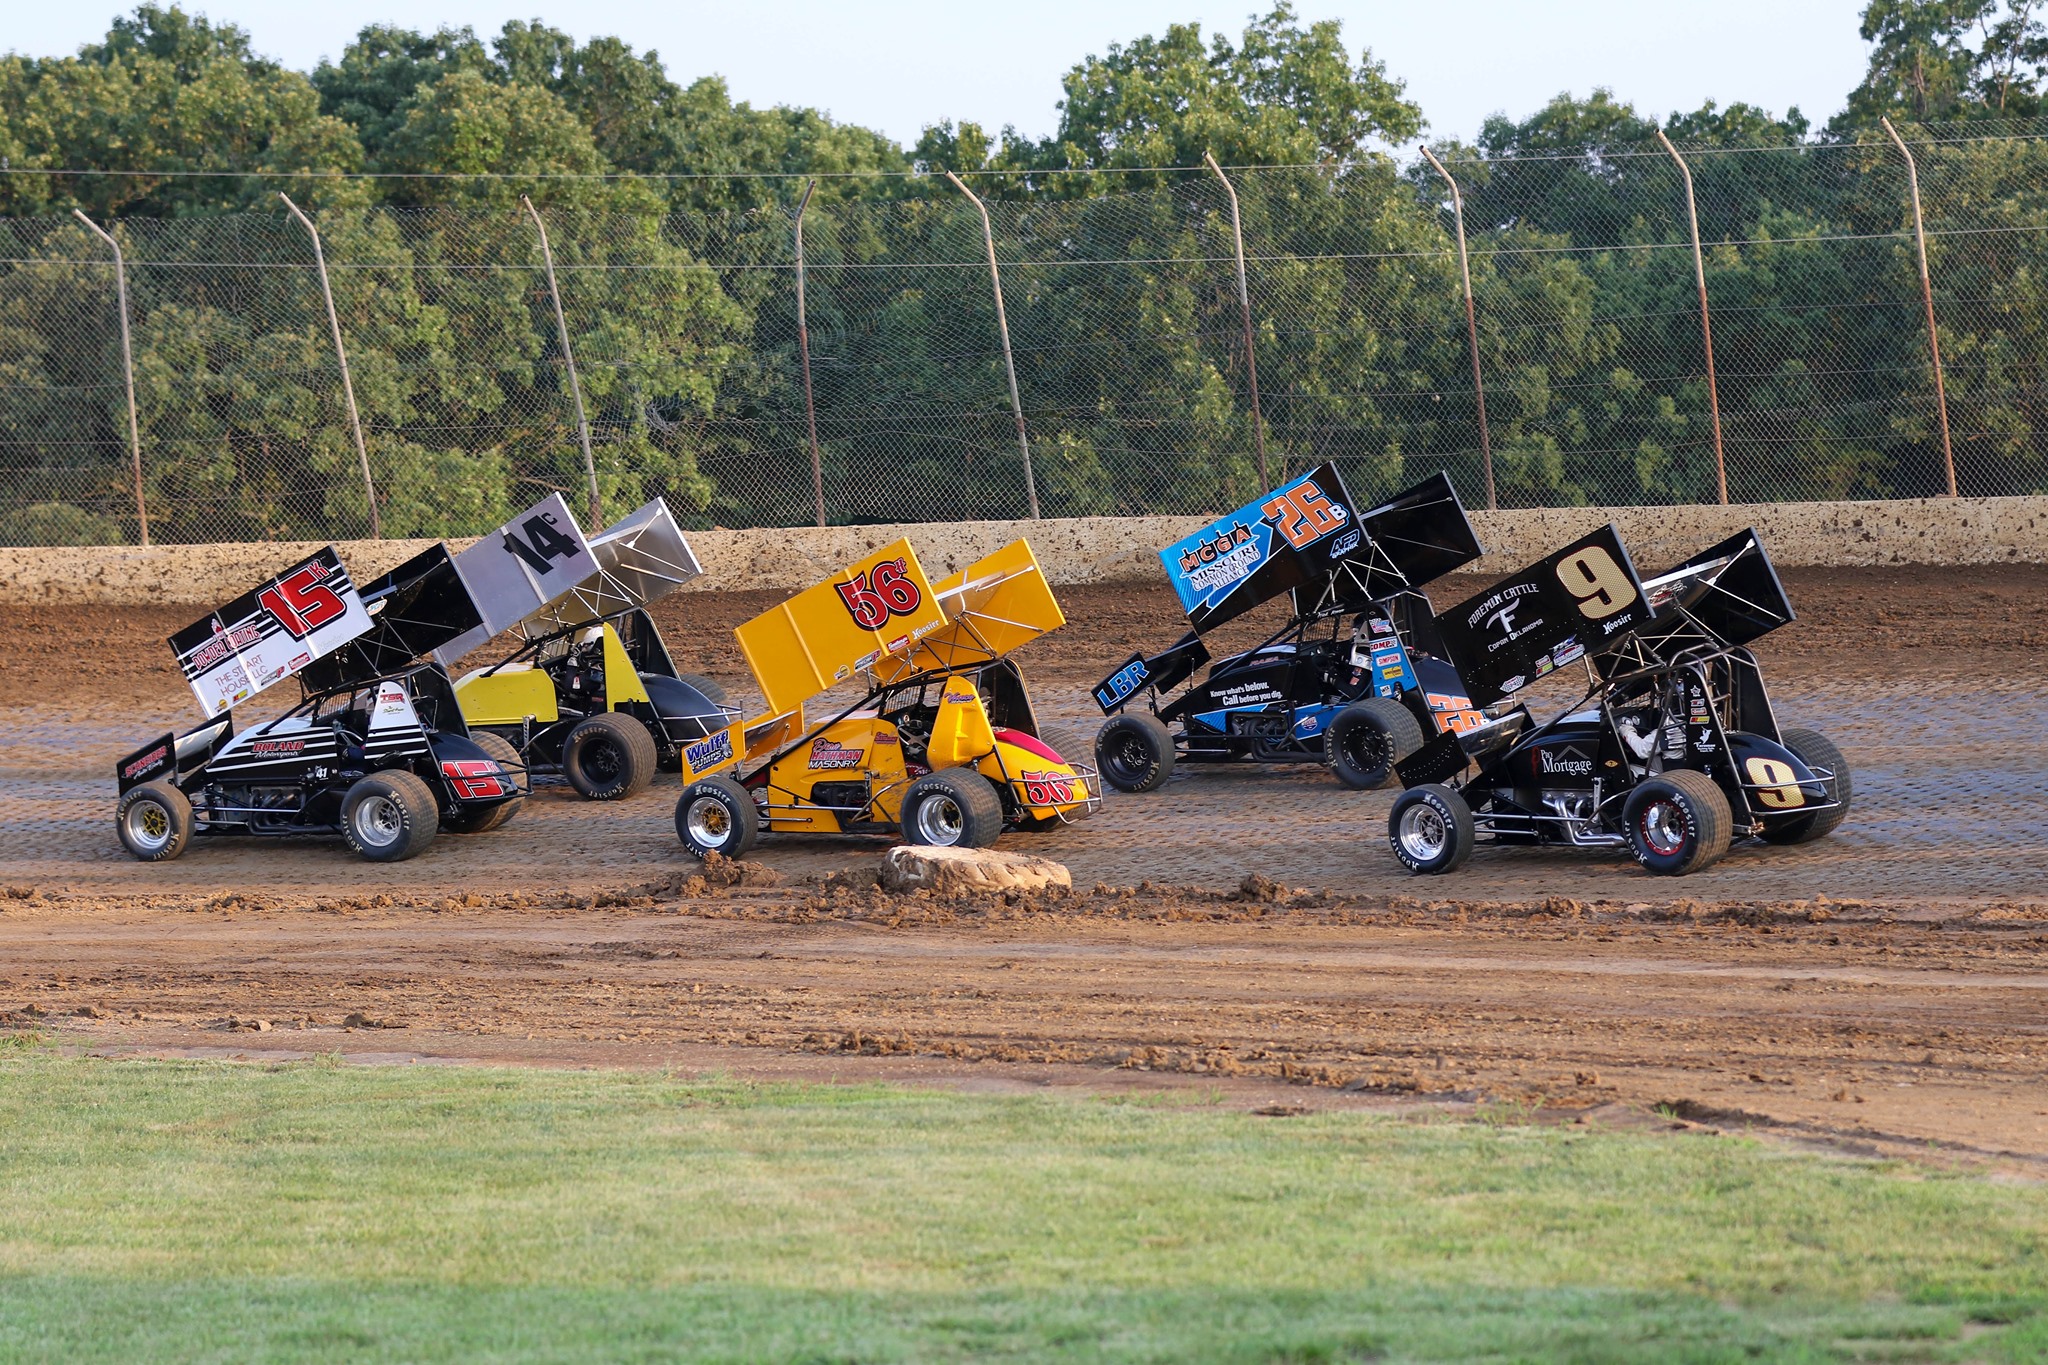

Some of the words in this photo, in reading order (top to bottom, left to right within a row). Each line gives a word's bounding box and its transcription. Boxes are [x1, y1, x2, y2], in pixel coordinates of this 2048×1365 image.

[1181, 526, 1251, 572] MCGA
[1191, 543, 1257, 582] MISSOURI
[1193, 569, 1228, 591] COMMON
[1228, 551, 1261, 573] GROUND
[1213, 565, 1250, 590] ALLIANCE
[1556, 545, 1637, 619] 9
[1503, 583, 1539, 600] CATTLE
[911, 619, 940, 641] Hoosier
[1602, 613, 1633, 636] Hoosier
[191, 639, 227, 671] POWDER
[215, 671, 232, 687] THE
[220, 674, 251, 696] HOUSE
[252, 665, 268, 679] LLC
[1096, 660, 1150, 709] LBR
[1210, 689, 1227, 698] Know
[1226, 686, 1245, 695] what's
[1244, 681, 1270, 692] below.
[1223, 695, 1239, 706] Call
[1239, 694, 1260, 704] before
[1259, 693, 1272, 701] you
[1271, 690, 1283, 699] dig.
[253, 740, 305, 752] BOLAND
[572, 726, 608, 744] Hoosier
[685, 730, 730, 762] Wulff
[1326, 727, 1338, 769] Hoosier
[691, 751, 723, 769] PUMPS
[808, 760, 859, 769] MASONRY
[811, 750, 863, 760] HATHMAN
[1382, 731, 1394, 773] Hoosier
[1542, 758, 1593, 775] Mortgage
[589, 782, 625, 799] Hoosier
[1132, 760, 1160, 791] Hoosier
[1746, 757, 1806, 808] 9
[695, 784, 731, 804] Hoosier
[388, 790, 411, 831] Hoosier
[1422, 793, 1453, 830] Hoosier
[1671, 793, 1696, 838] Hoosier
[153, 830, 180, 860] Hoosier
[341, 814, 364, 853] Hoosier
[1624, 820, 1648, 865] Hoosier
[1390, 836, 1419, 871] Hoosier
